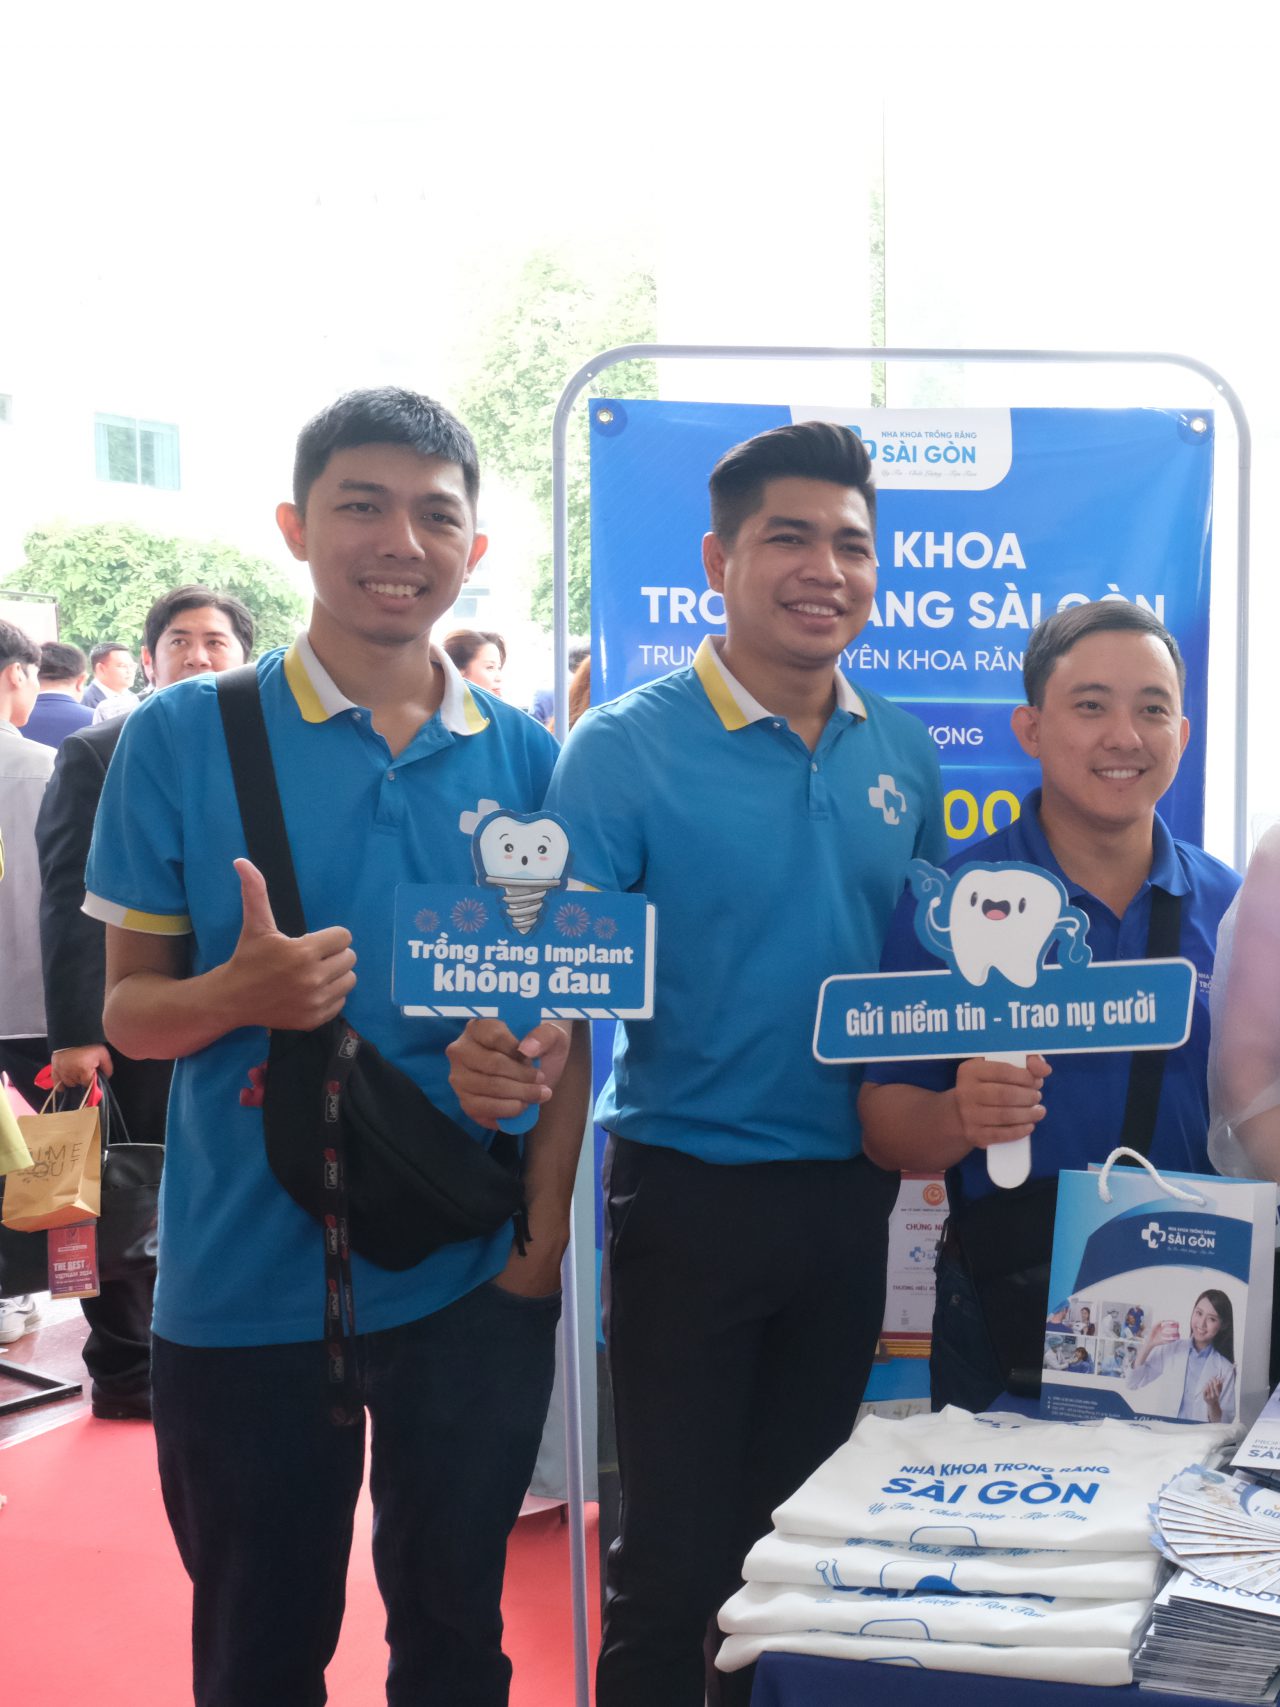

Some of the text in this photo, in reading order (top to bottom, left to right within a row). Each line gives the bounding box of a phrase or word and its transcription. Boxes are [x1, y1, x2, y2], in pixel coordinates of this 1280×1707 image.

[882, 440, 976, 464] SÀI GÒN
[893, 531, 1027, 570] KHOA
[638, 645, 696, 666] TRUN
[897, 649, 968, 671] KHOA
[974, 645, 1024, 671] RĂN
[408, 932, 634, 967] Trồng răng Implant
[433, 962, 611, 999] không đau
[845, 1002, 884, 1036] Gửi
[891, 1000, 949, 1034] niềm
[956, 1001, 986, 1032] tin
[1008, 1000, 1059, 1029] Trao
[1067, 1001, 1096, 1032] nụ
[1103, 989, 1156, 1024] cười
[28, 1142, 83, 1161] IME
[1168, 1232, 1216, 1249] SÀI GÒN
[899, 1465, 936, 1476] NHA
[940, 1463, 988, 1477] KHOA
[881, 1474, 1100, 1505] SÀI GÒN
